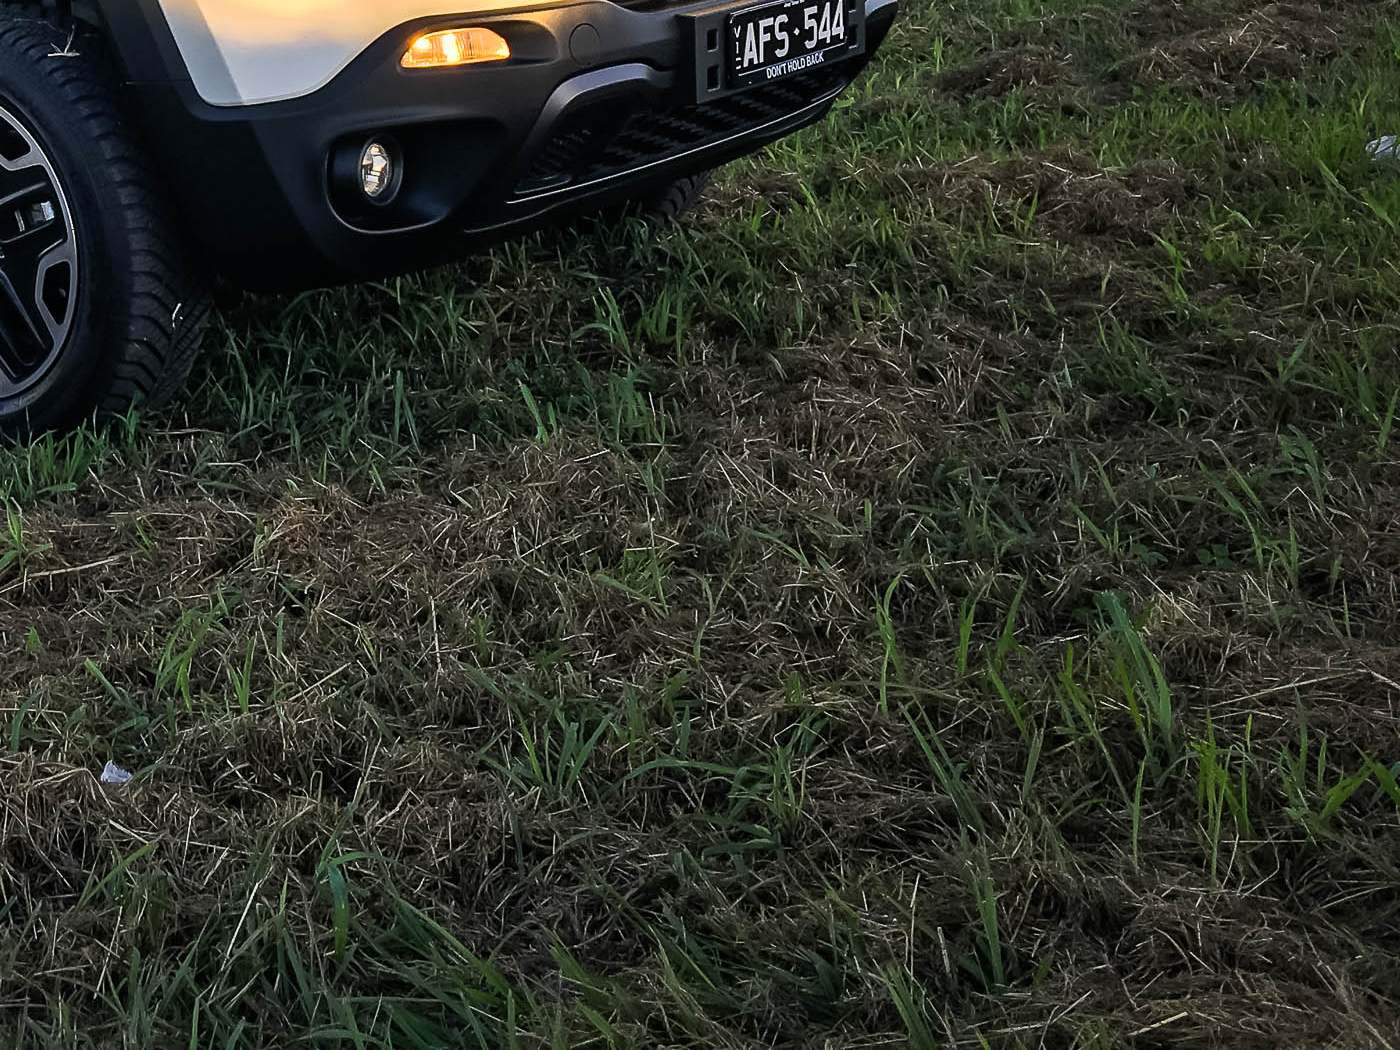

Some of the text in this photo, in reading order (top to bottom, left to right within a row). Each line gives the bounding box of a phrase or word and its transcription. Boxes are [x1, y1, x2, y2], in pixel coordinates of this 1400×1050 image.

[743, 14, 789, 67] AFS
[766, 51, 825, 79] DON'T HOLD BACK
